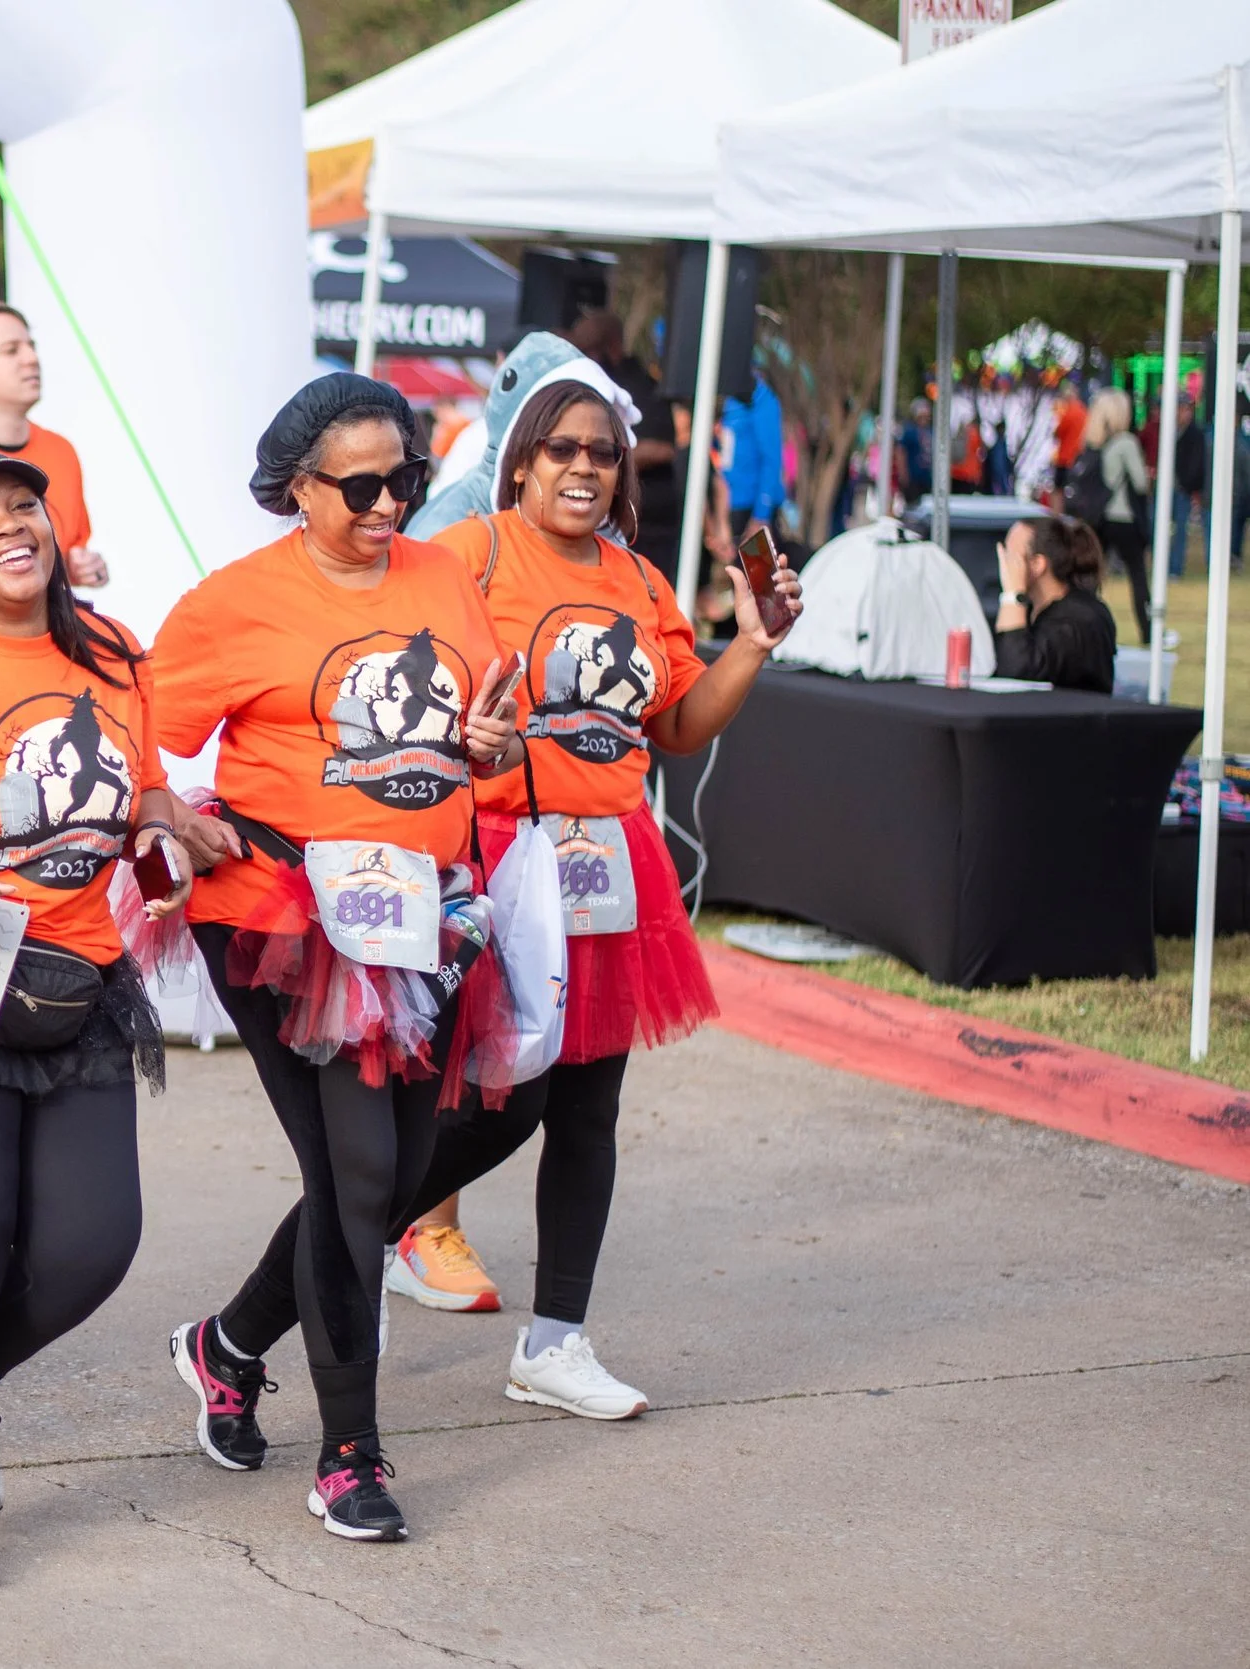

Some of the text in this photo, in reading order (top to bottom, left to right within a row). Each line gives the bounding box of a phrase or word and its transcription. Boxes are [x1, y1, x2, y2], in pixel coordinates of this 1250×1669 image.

[576, 734, 618, 759] 2025
[349, 757, 398, 776] MCKINNEY
[399, 752, 438, 766] MONSTER
[384, 780, 440, 804] 2025
[39, 858, 97, 883] 2025
[336, 890, 403, 928] 891
[586, 896, 620, 907] TEXANS
